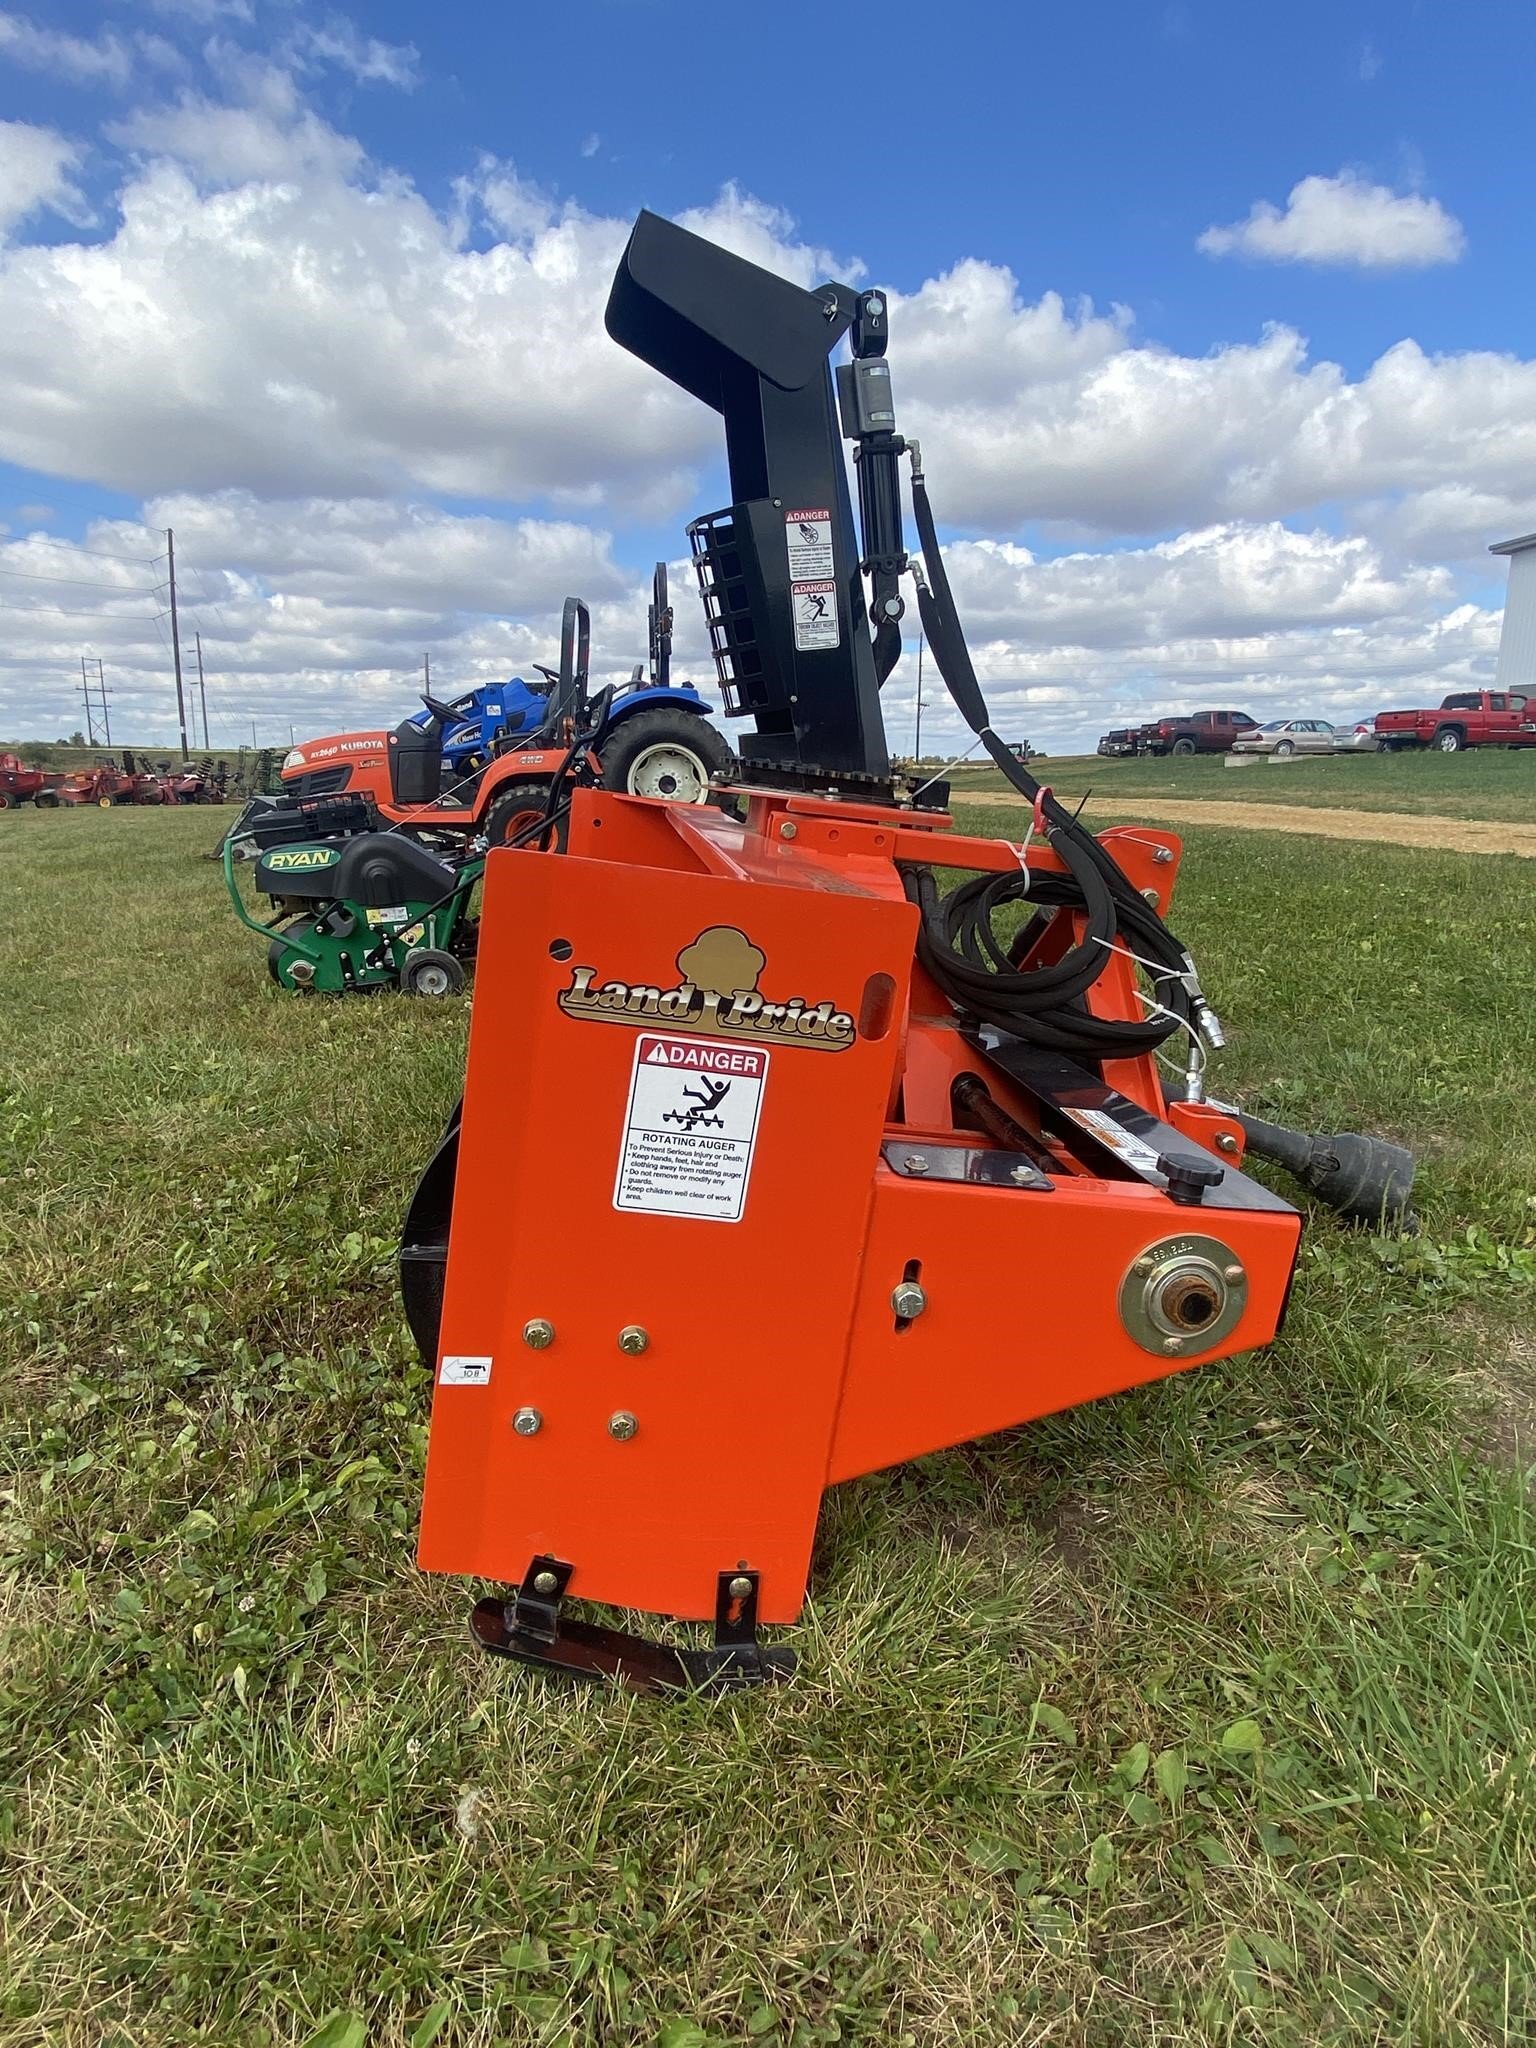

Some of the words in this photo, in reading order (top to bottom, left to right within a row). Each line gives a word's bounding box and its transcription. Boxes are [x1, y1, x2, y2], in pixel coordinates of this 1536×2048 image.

[793, 511, 830, 521] DANGER
[799, 583, 833, 593] DANGER
[340, 740, 384, 752] KUBOTA
[268, 851, 331, 868] RYAN
[565, 966, 697, 1018] Land
[722, 989, 853, 1040] Pride
[669, 1046, 759, 1074] DANGER
[642, 1133, 696, 1148] ROTATING
[698, 1140, 736, 1152] AUGER
[629, 1143, 638, 1151] To
[639, 1145, 666, 1154] Prevent
[666, 1148, 693, 1157] Serious
[693, 1151, 714, 1161] Injury
[632, 1152, 650, 1161] Keep
[650, 1154, 674, 1164] hands,
[675, 1157, 690, 1166] feet,
[690, 1158, 705, 1166] hair
[629, 1168, 640, 1176] Do
[652, 1172, 679, 1180] remove
[688, 1176, 712, 1185] modify
[630, 1161, 659, 1171] clothing
[678, 1165, 695, 1173] from
[695, 1168, 722, 1178] rotating
[722, 1171, 744, 1180] auger.
[627, 1177, 654, 1186] guards.
[625, 1193, 643, 1201] area.
[627, 1184, 645, 1194] Keep
[645, 1187, 674, 1196] children
[688, 1191, 706, 1199] clear
